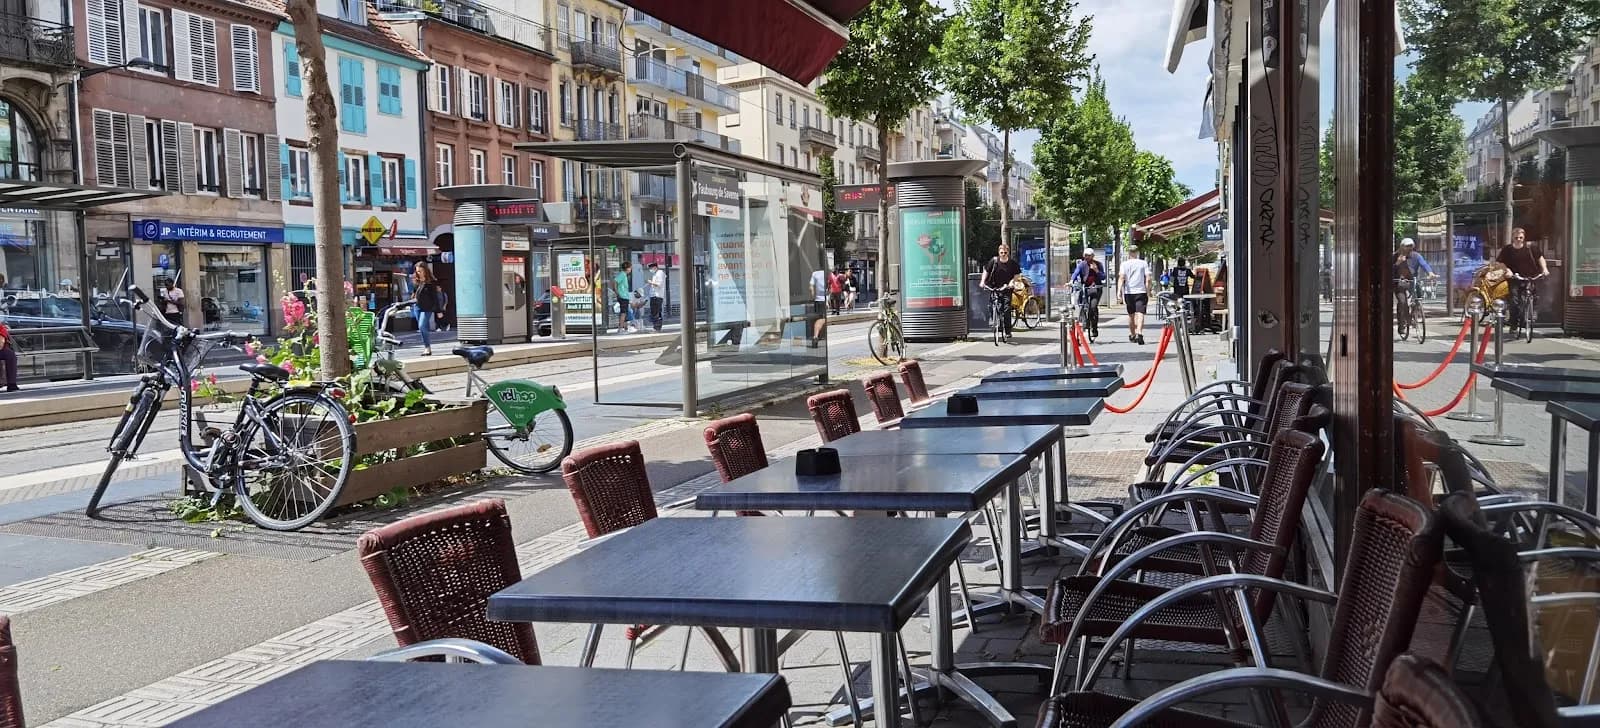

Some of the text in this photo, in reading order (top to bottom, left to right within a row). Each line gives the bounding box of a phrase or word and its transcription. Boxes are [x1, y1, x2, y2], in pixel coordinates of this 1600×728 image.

[178, 226, 208, 237] INTÉRIM
[209, 229, 215, 238] &
[216, 230, 266, 240] RECRUTEMENT
[566, 277, 587, 290] BIO
